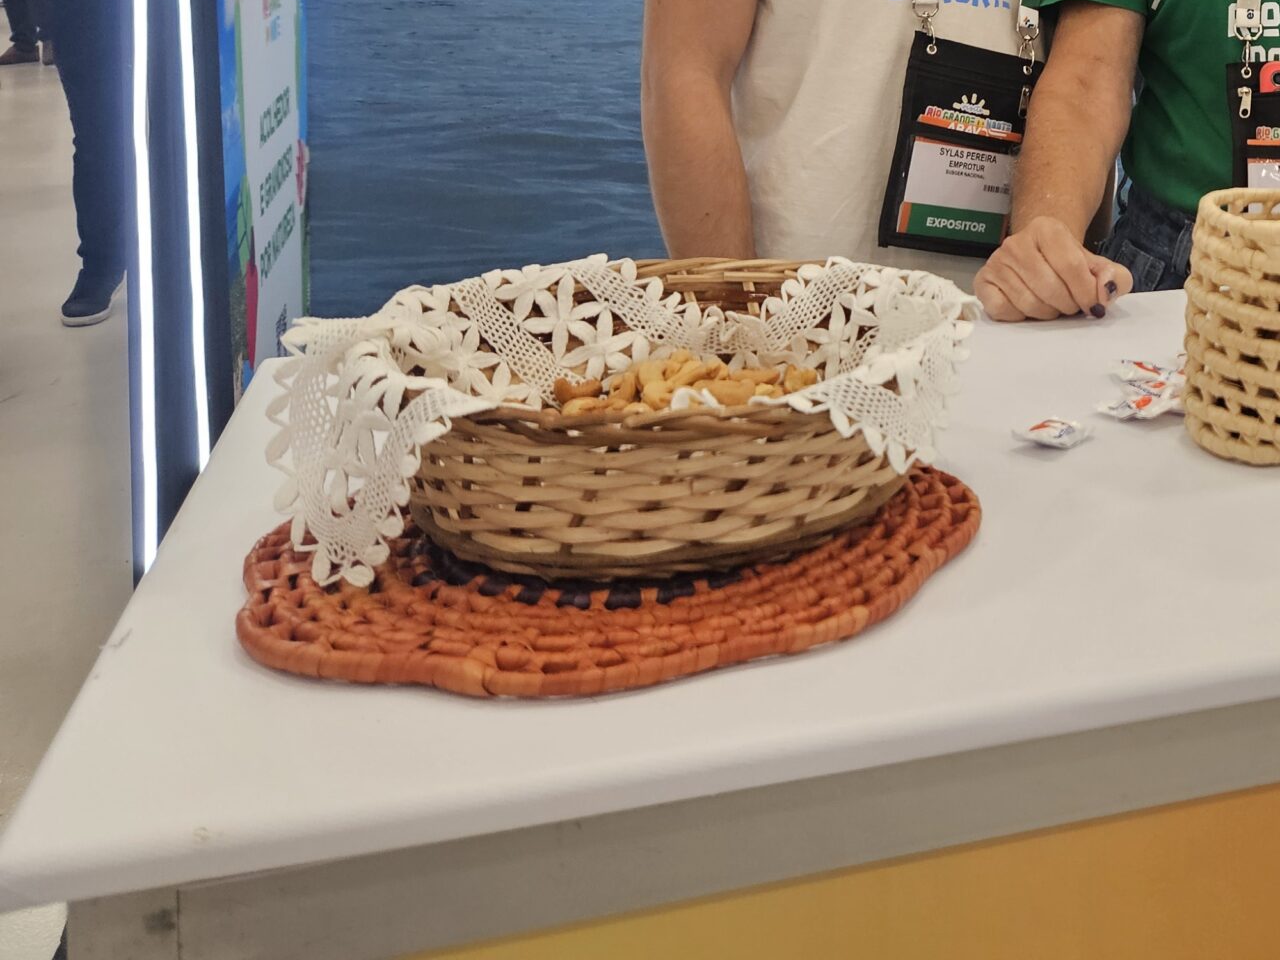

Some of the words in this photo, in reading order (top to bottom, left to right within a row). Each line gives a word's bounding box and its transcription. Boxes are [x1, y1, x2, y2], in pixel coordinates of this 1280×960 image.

[939, 147, 965, 159] SYLAS
[966, 151, 997, 164] PEREIRA
[948, 160, 985, 172] EMPROTUR
[926, 216, 986, 233] EXPOSITOR
